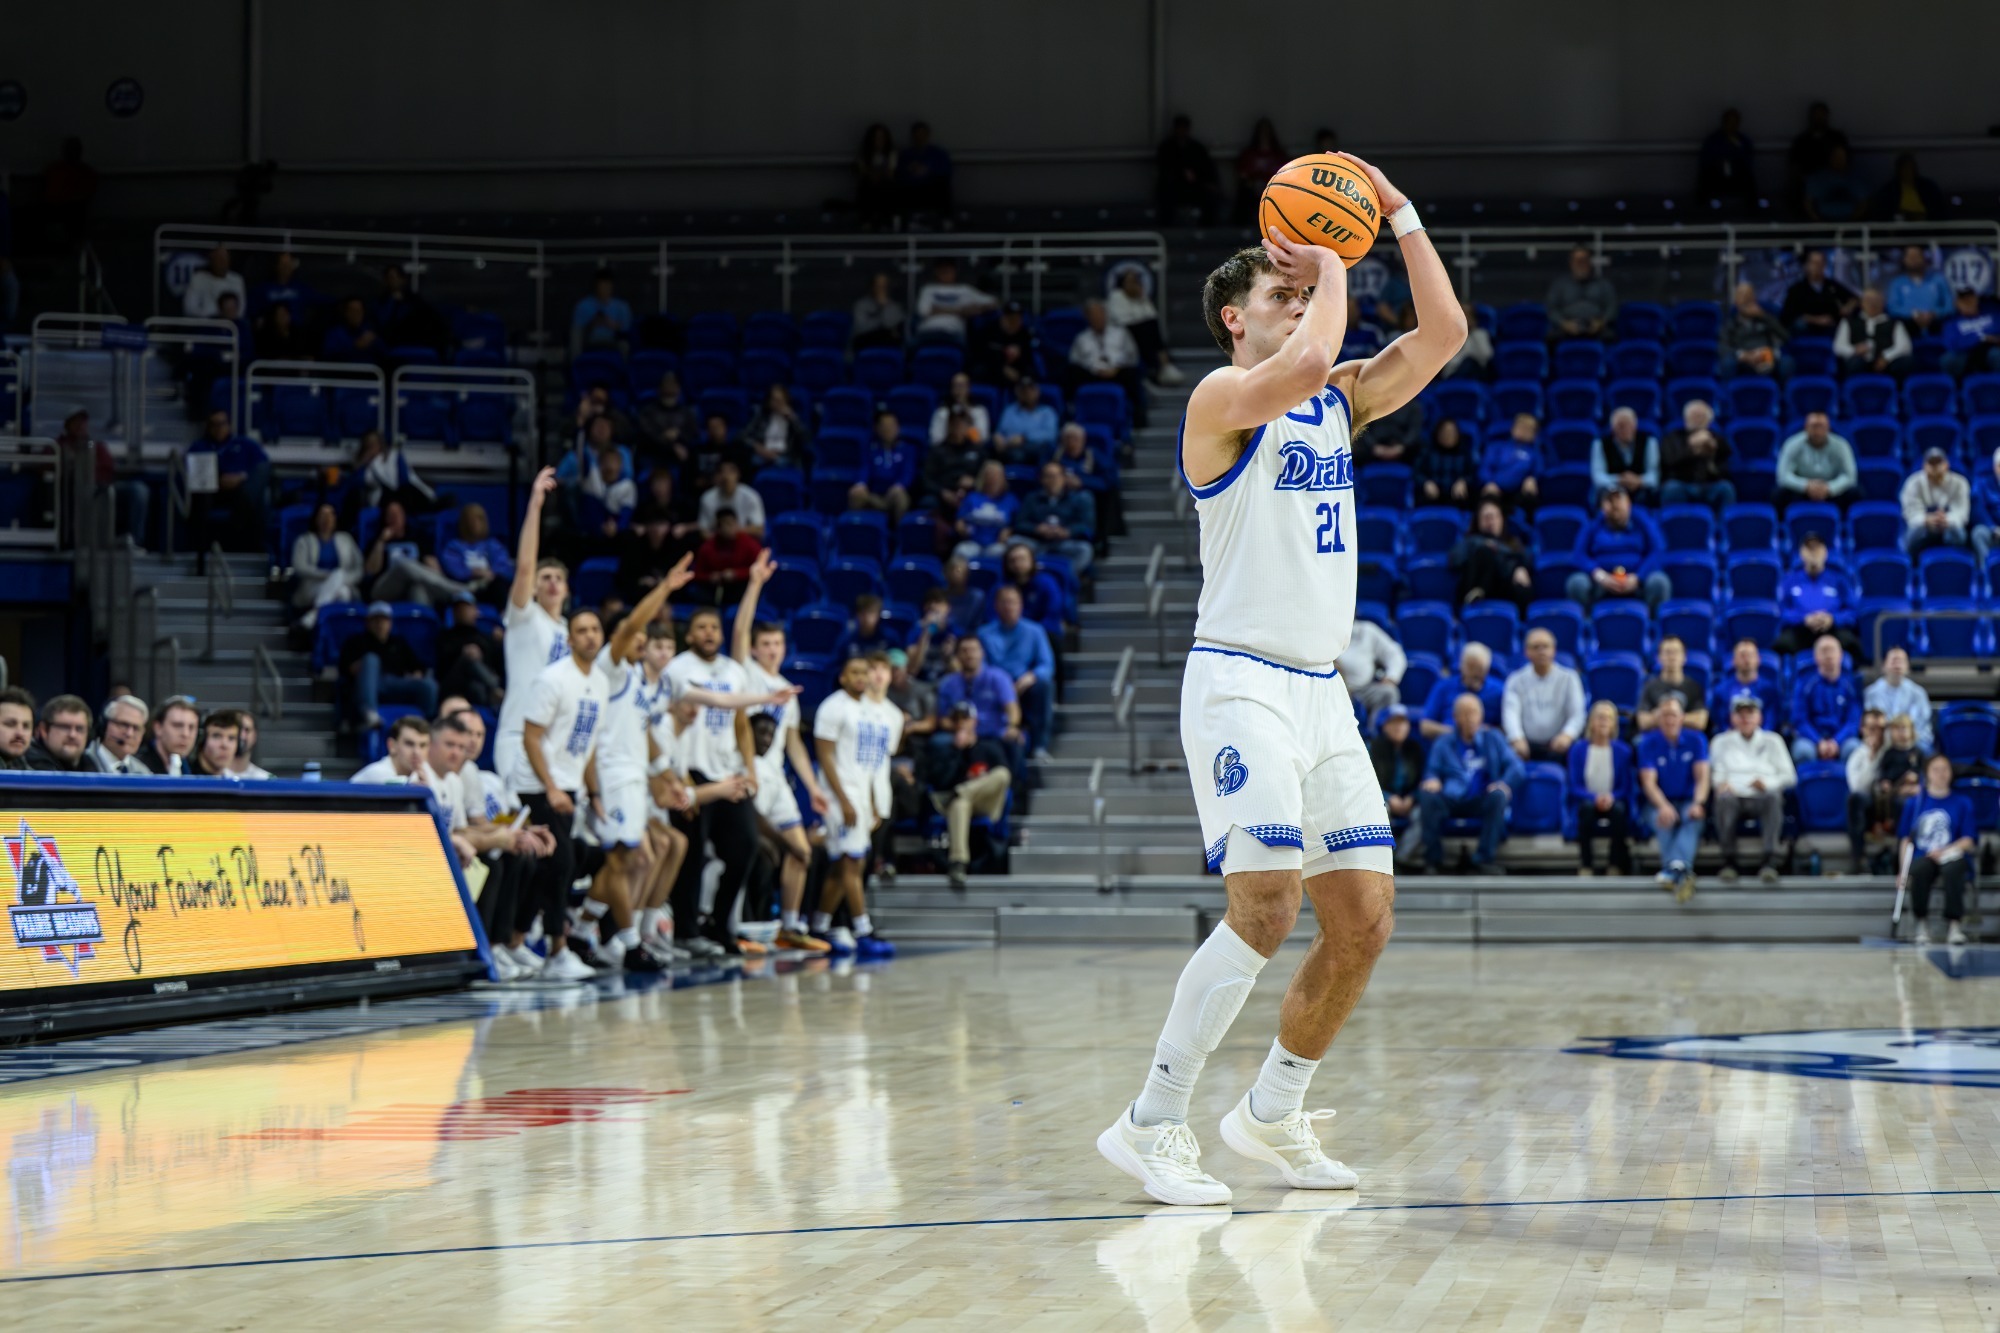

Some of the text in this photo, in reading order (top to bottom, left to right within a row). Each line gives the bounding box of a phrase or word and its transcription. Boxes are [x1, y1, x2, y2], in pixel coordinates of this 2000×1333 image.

[1310, 168, 1377, 223] Wilson
[1306, 212, 1354, 244] EVO
[1950, 260, 1982, 282] 117
[1315, 502, 1346, 554] 21
[95, 844, 158, 974] Your
[157, 844, 237, 918] Favorite
[230, 844, 292, 914] Place
[300, 843, 366, 952] Play
